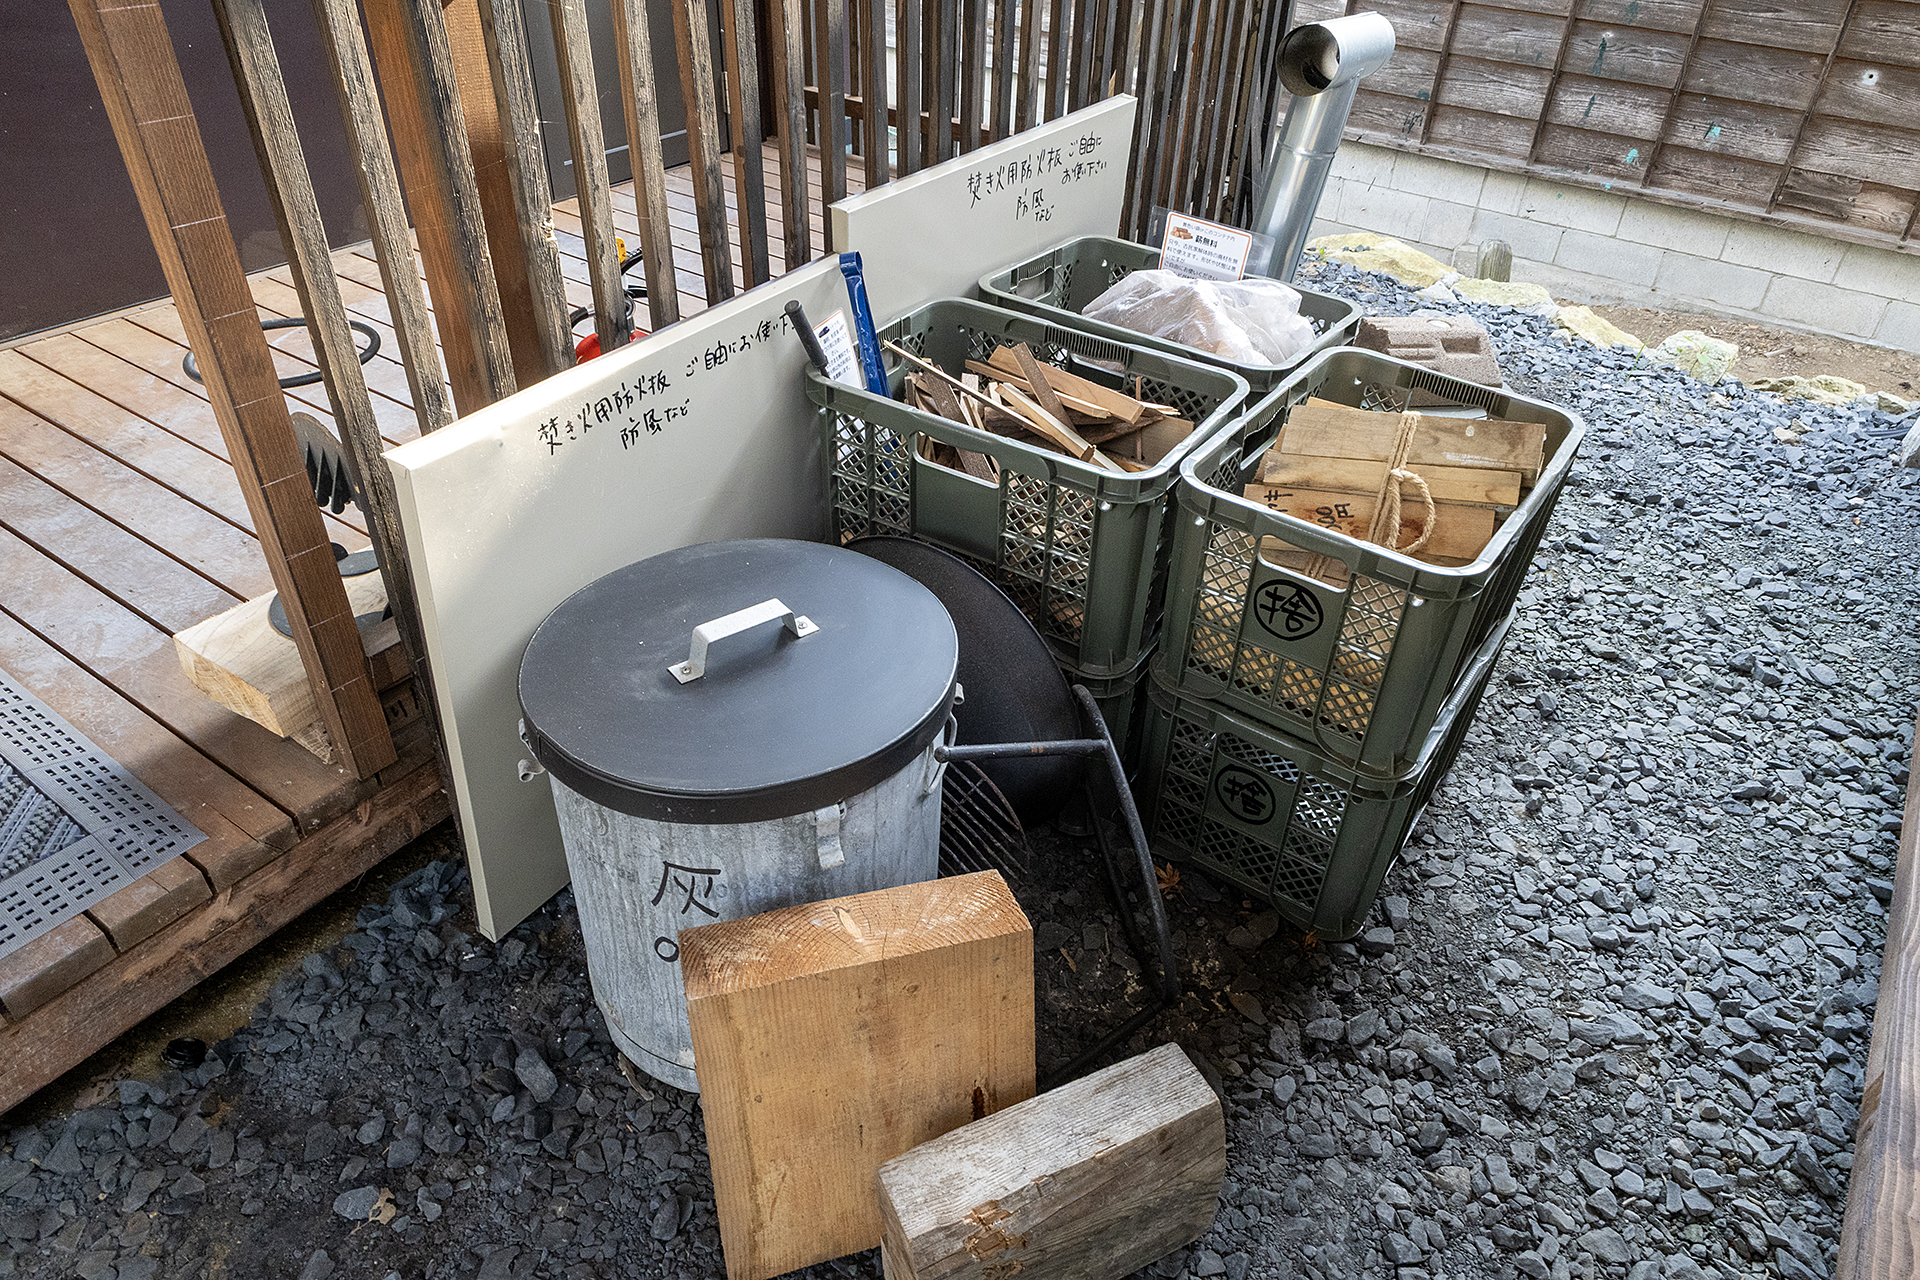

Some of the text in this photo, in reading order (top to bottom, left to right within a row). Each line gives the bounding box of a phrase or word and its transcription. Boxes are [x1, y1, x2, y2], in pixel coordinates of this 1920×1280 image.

[1194, 234, 1219, 249] 薪無料
[650, 860, 722, 918] 灰
